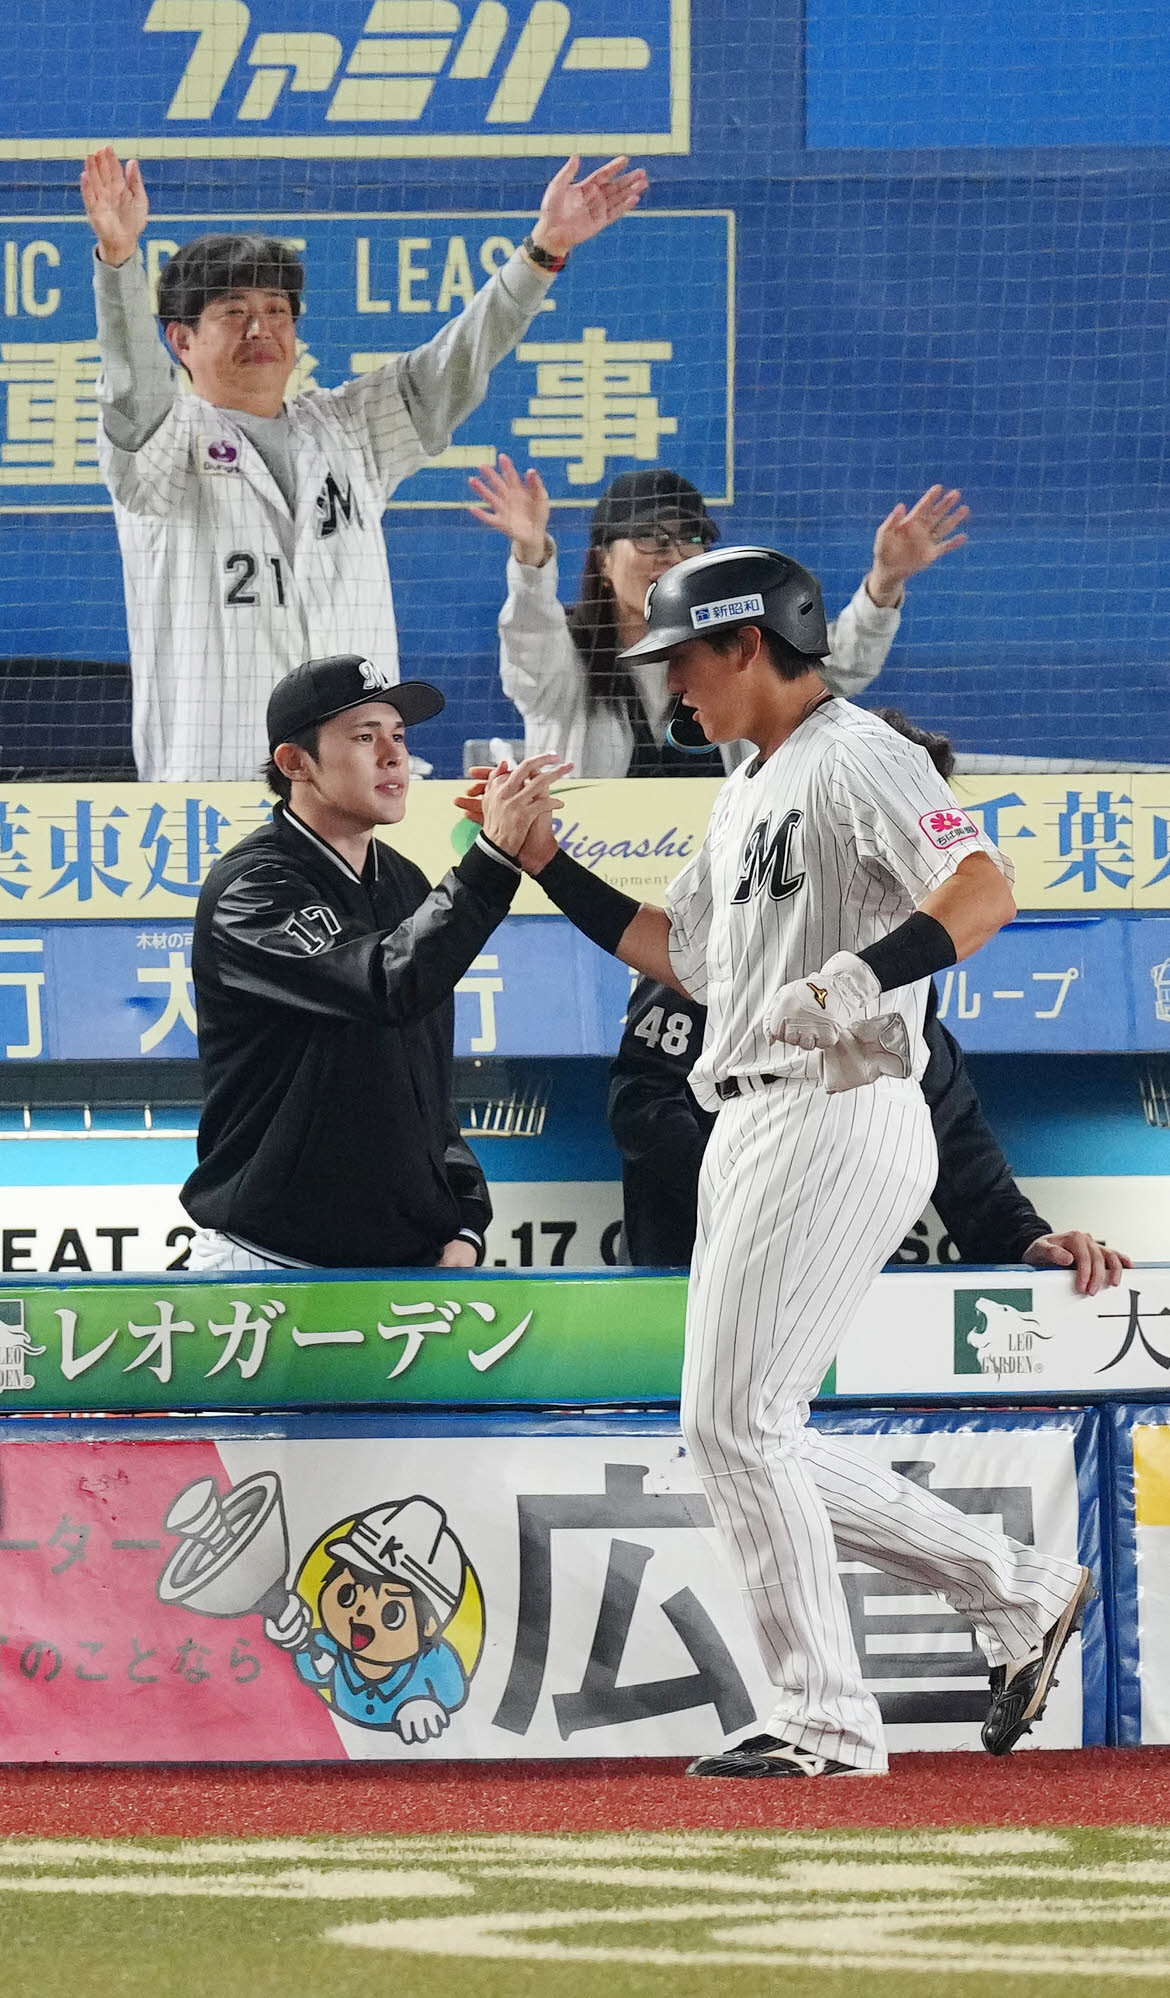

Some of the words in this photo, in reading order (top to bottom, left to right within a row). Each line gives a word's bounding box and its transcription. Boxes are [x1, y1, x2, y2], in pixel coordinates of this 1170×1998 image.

[143, 0, 652, 123] ファミリー
[224, 549, 288, 608] 21
[713, 599, 760, 619] 新昭和
[284, 904, 343, 956] 17
[634, 1005, 694, 1057] 48
[54, 1300, 534, 1384] レオガーデン
[1008, 1333, 1033, 1351] LEO
[378, 1535, 403, 1567] K
[0, 1635, 262, 1685] のことなら
